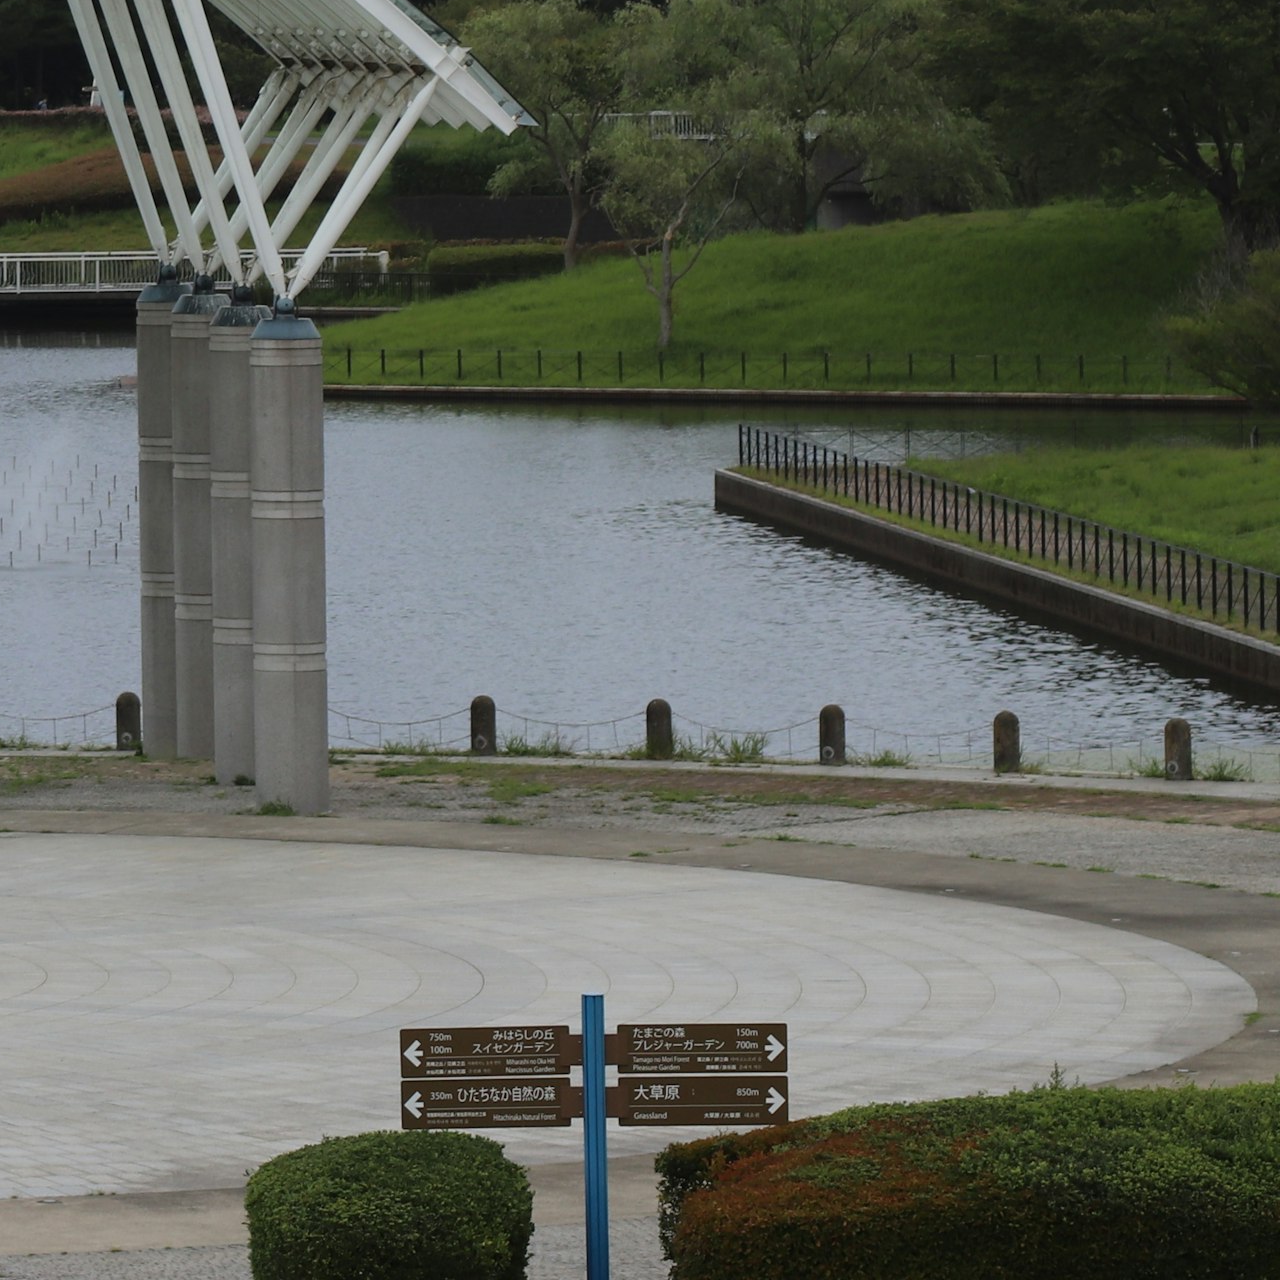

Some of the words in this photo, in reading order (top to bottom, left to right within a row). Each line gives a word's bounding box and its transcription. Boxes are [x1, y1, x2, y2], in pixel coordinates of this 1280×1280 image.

[429, 1033, 452, 1041] 750m
[493, 1029, 554, 1040] みはらしの丘
[633, 1027, 685, 1038] たまごの森
[736, 1028, 758, 1037] 150m
[430, 1045, 452, 1054] 100m
[472, 1042, 555, 1054] スイセンガーデン
[736, 1040, 758, 1049] 700m
[533, 1065, 556, 1073] Garden
[658, 1063, 680, 1071] Garden
[430, 1091, 453, 1100] 350m
[457, 1086, 556, 1102] ひたちなか自然の森
[634, 1084, 680, 1101] 大草原
[736, 1088, 759, 1097] 850m
[634, 1111, 668, 1120] Grassland
